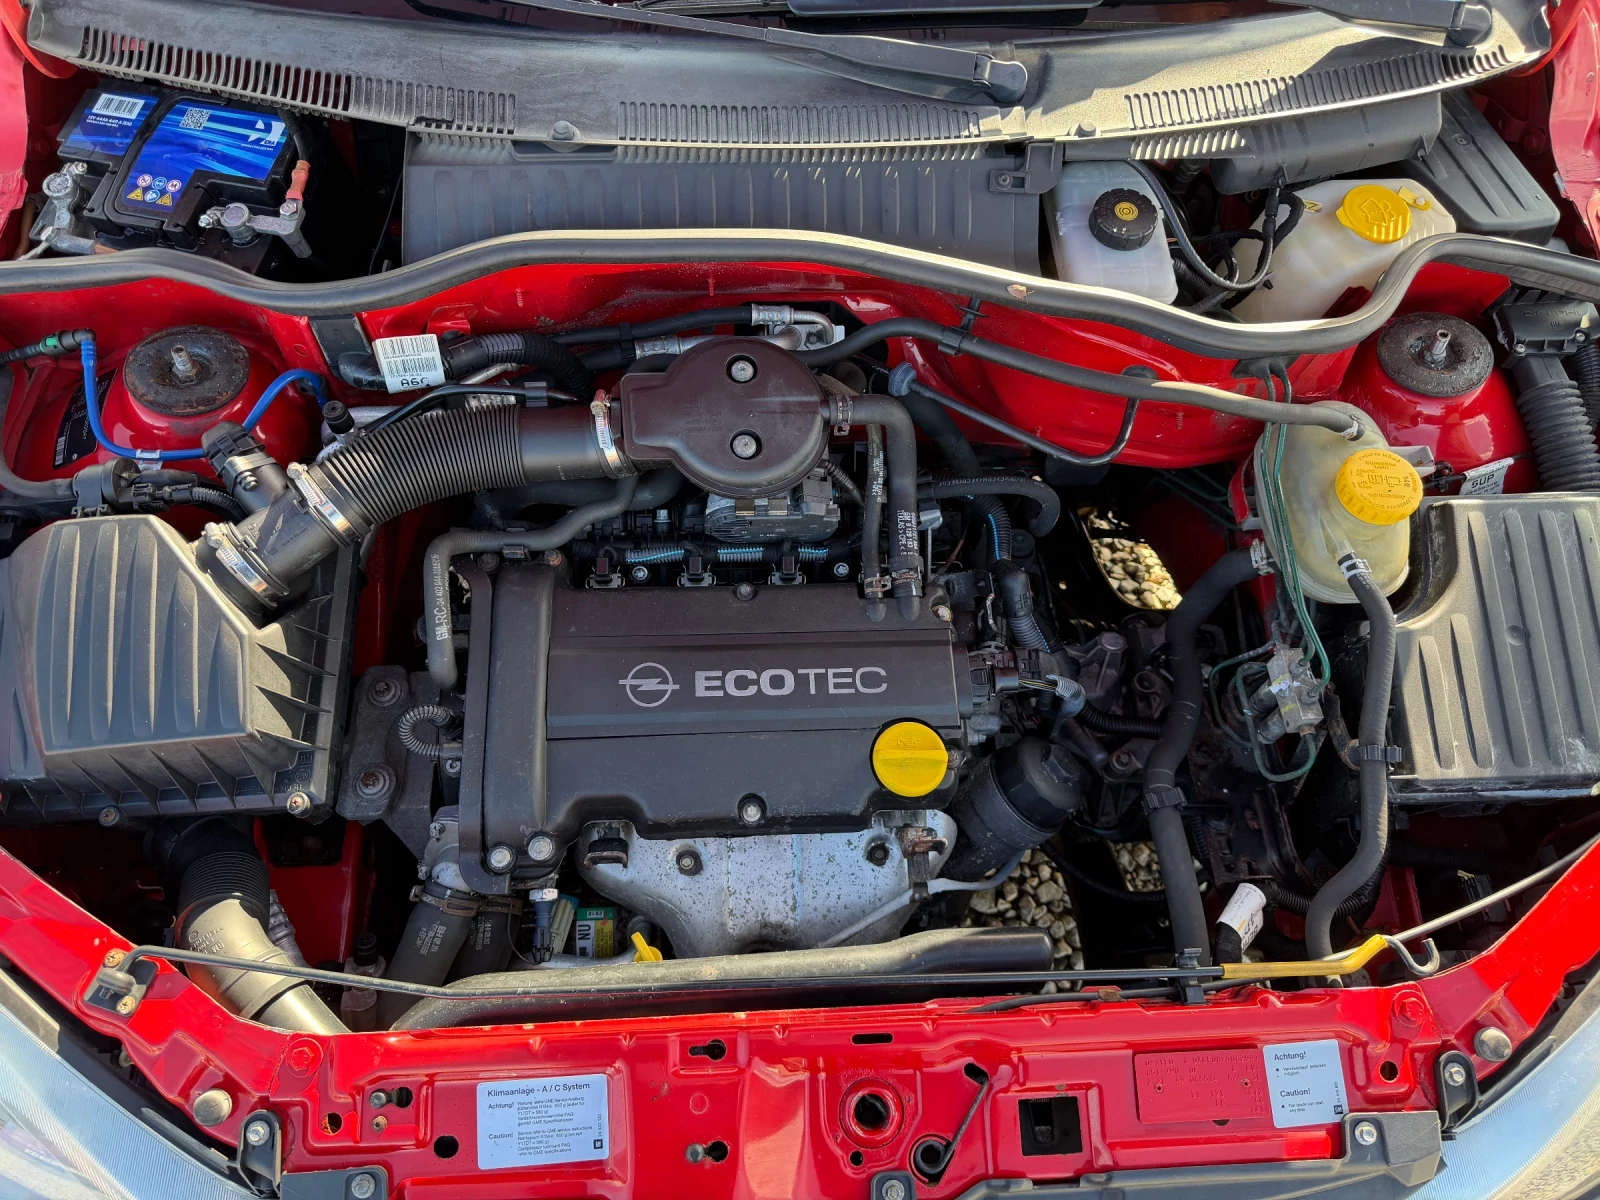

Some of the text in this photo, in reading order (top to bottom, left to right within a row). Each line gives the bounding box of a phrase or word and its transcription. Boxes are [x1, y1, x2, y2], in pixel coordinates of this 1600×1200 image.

[694, 666, 888, 698] ECOTEC
[1274, 1051, 1306, 1061] Achtung!
[488, 1088, 535, 1097] Klimaanlage
[562, 1083, 590, 1091] System
[1280, 1088, 1311, 1097] Caution!
